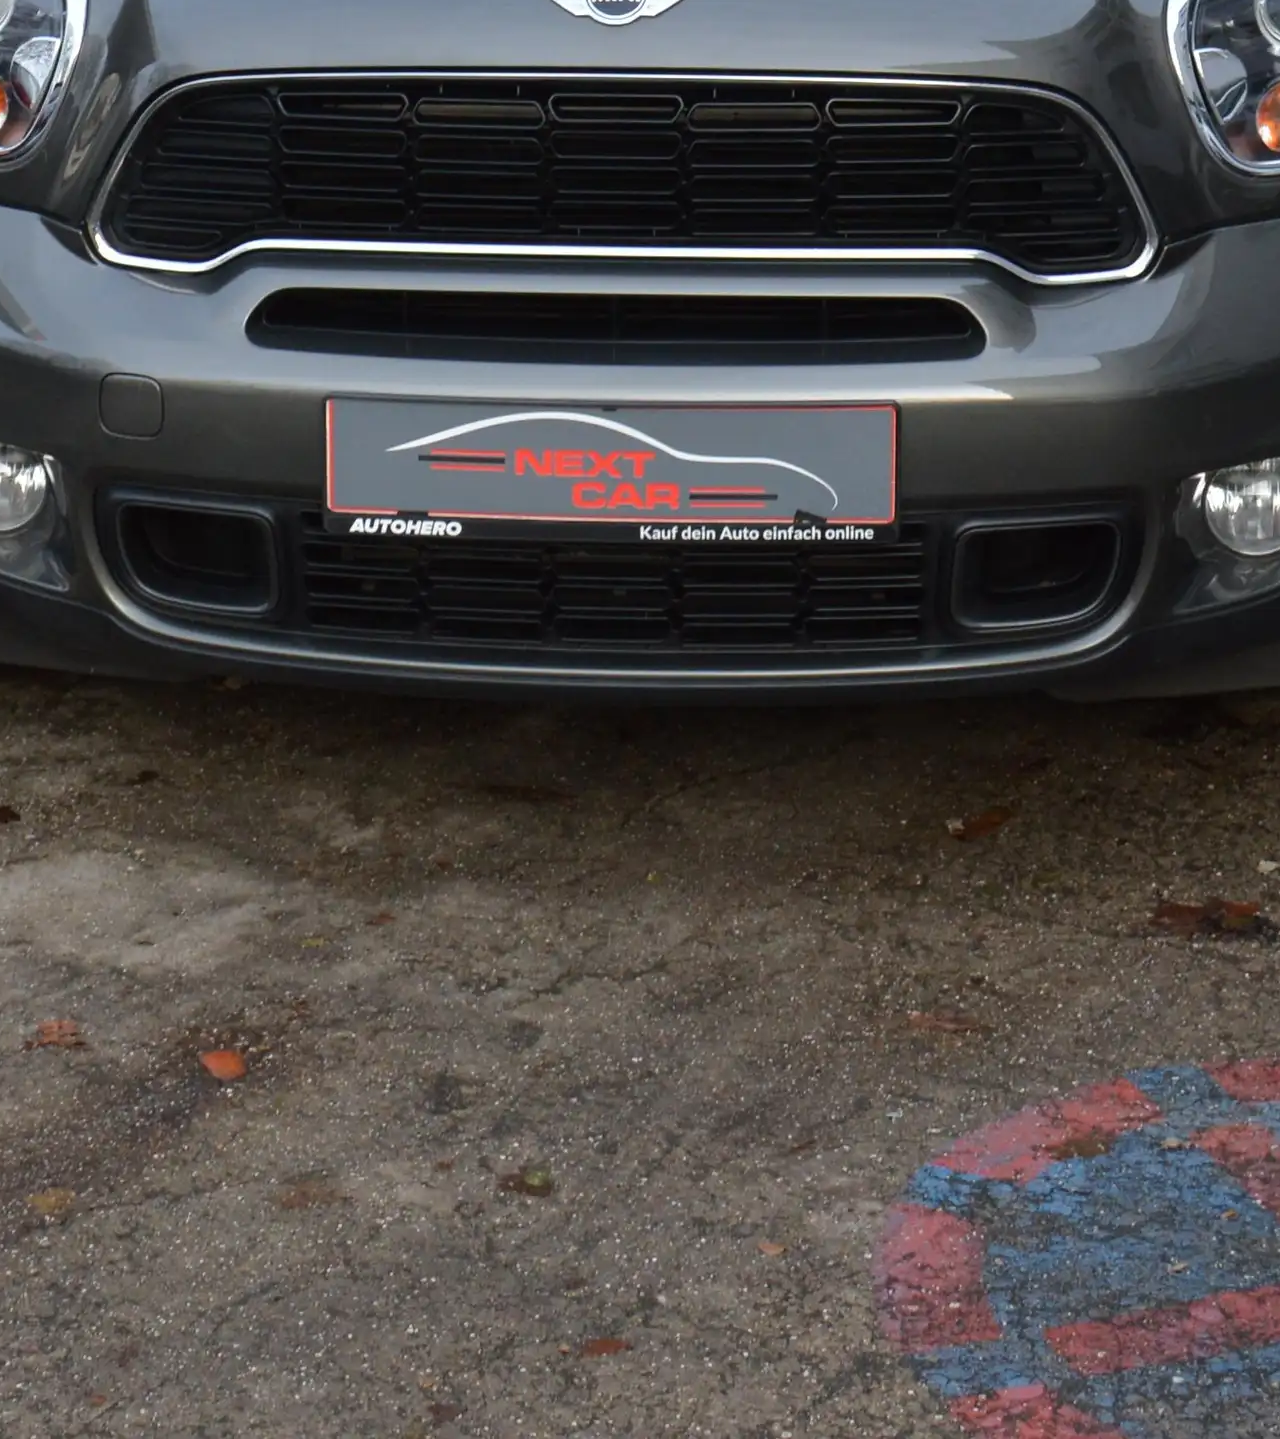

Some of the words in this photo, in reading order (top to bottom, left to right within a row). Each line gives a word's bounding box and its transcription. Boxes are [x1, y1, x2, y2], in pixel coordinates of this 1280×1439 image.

[513, 448, 656, 479] NEXT
[570, 481, 681, 510] CAR
[349, 517, 463, 537] AUTOHERO
[638, 524, 679, 541] Kauf
[680, 524, 715, 541] dein
[718, 525, 760, 541] Auto
[761, 524, 821, 541] einfach
[824, 526, 875, 541] online
